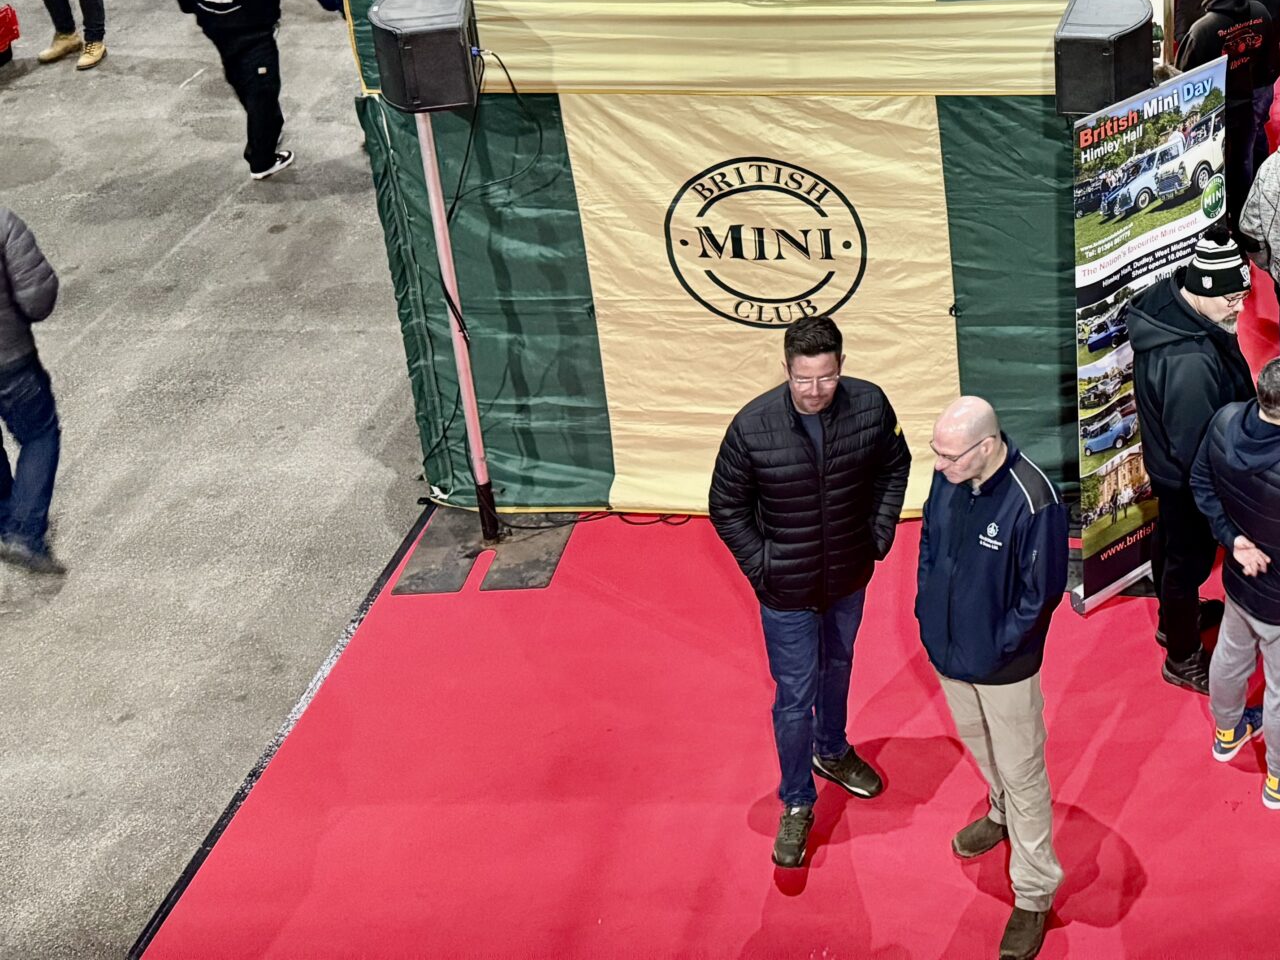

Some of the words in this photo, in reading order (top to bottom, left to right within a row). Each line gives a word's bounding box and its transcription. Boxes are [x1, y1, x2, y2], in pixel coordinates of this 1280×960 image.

[1079, 109, 1139, 148] British
[1143, 89, 1179, 120] Mini
[1182, 77, 1213, 102] Day
[1080, 140, 1120, 164] Himley
[1123, 124, 1143, 145] Hall
[691, 164, 831, 202] BRITISH
[694, 224, 836, 260] MINI
[1082, 267, 1098, 278] The
[1099, 250, 1126, 271] Nation's
[1127, 234, 1159, 257] favourite
[1160, 226, 1176, 238] Mini
[1133, 254, 1155, 270] Dudley,
[1155, 247, 1170, 258] West
[1171, 236, 1198, 251] Midlands,
[1131, 266, 1148, 279] Show
[1148, 259, 1167, 271] opens
[733, 299, 818, 323] CLUB
